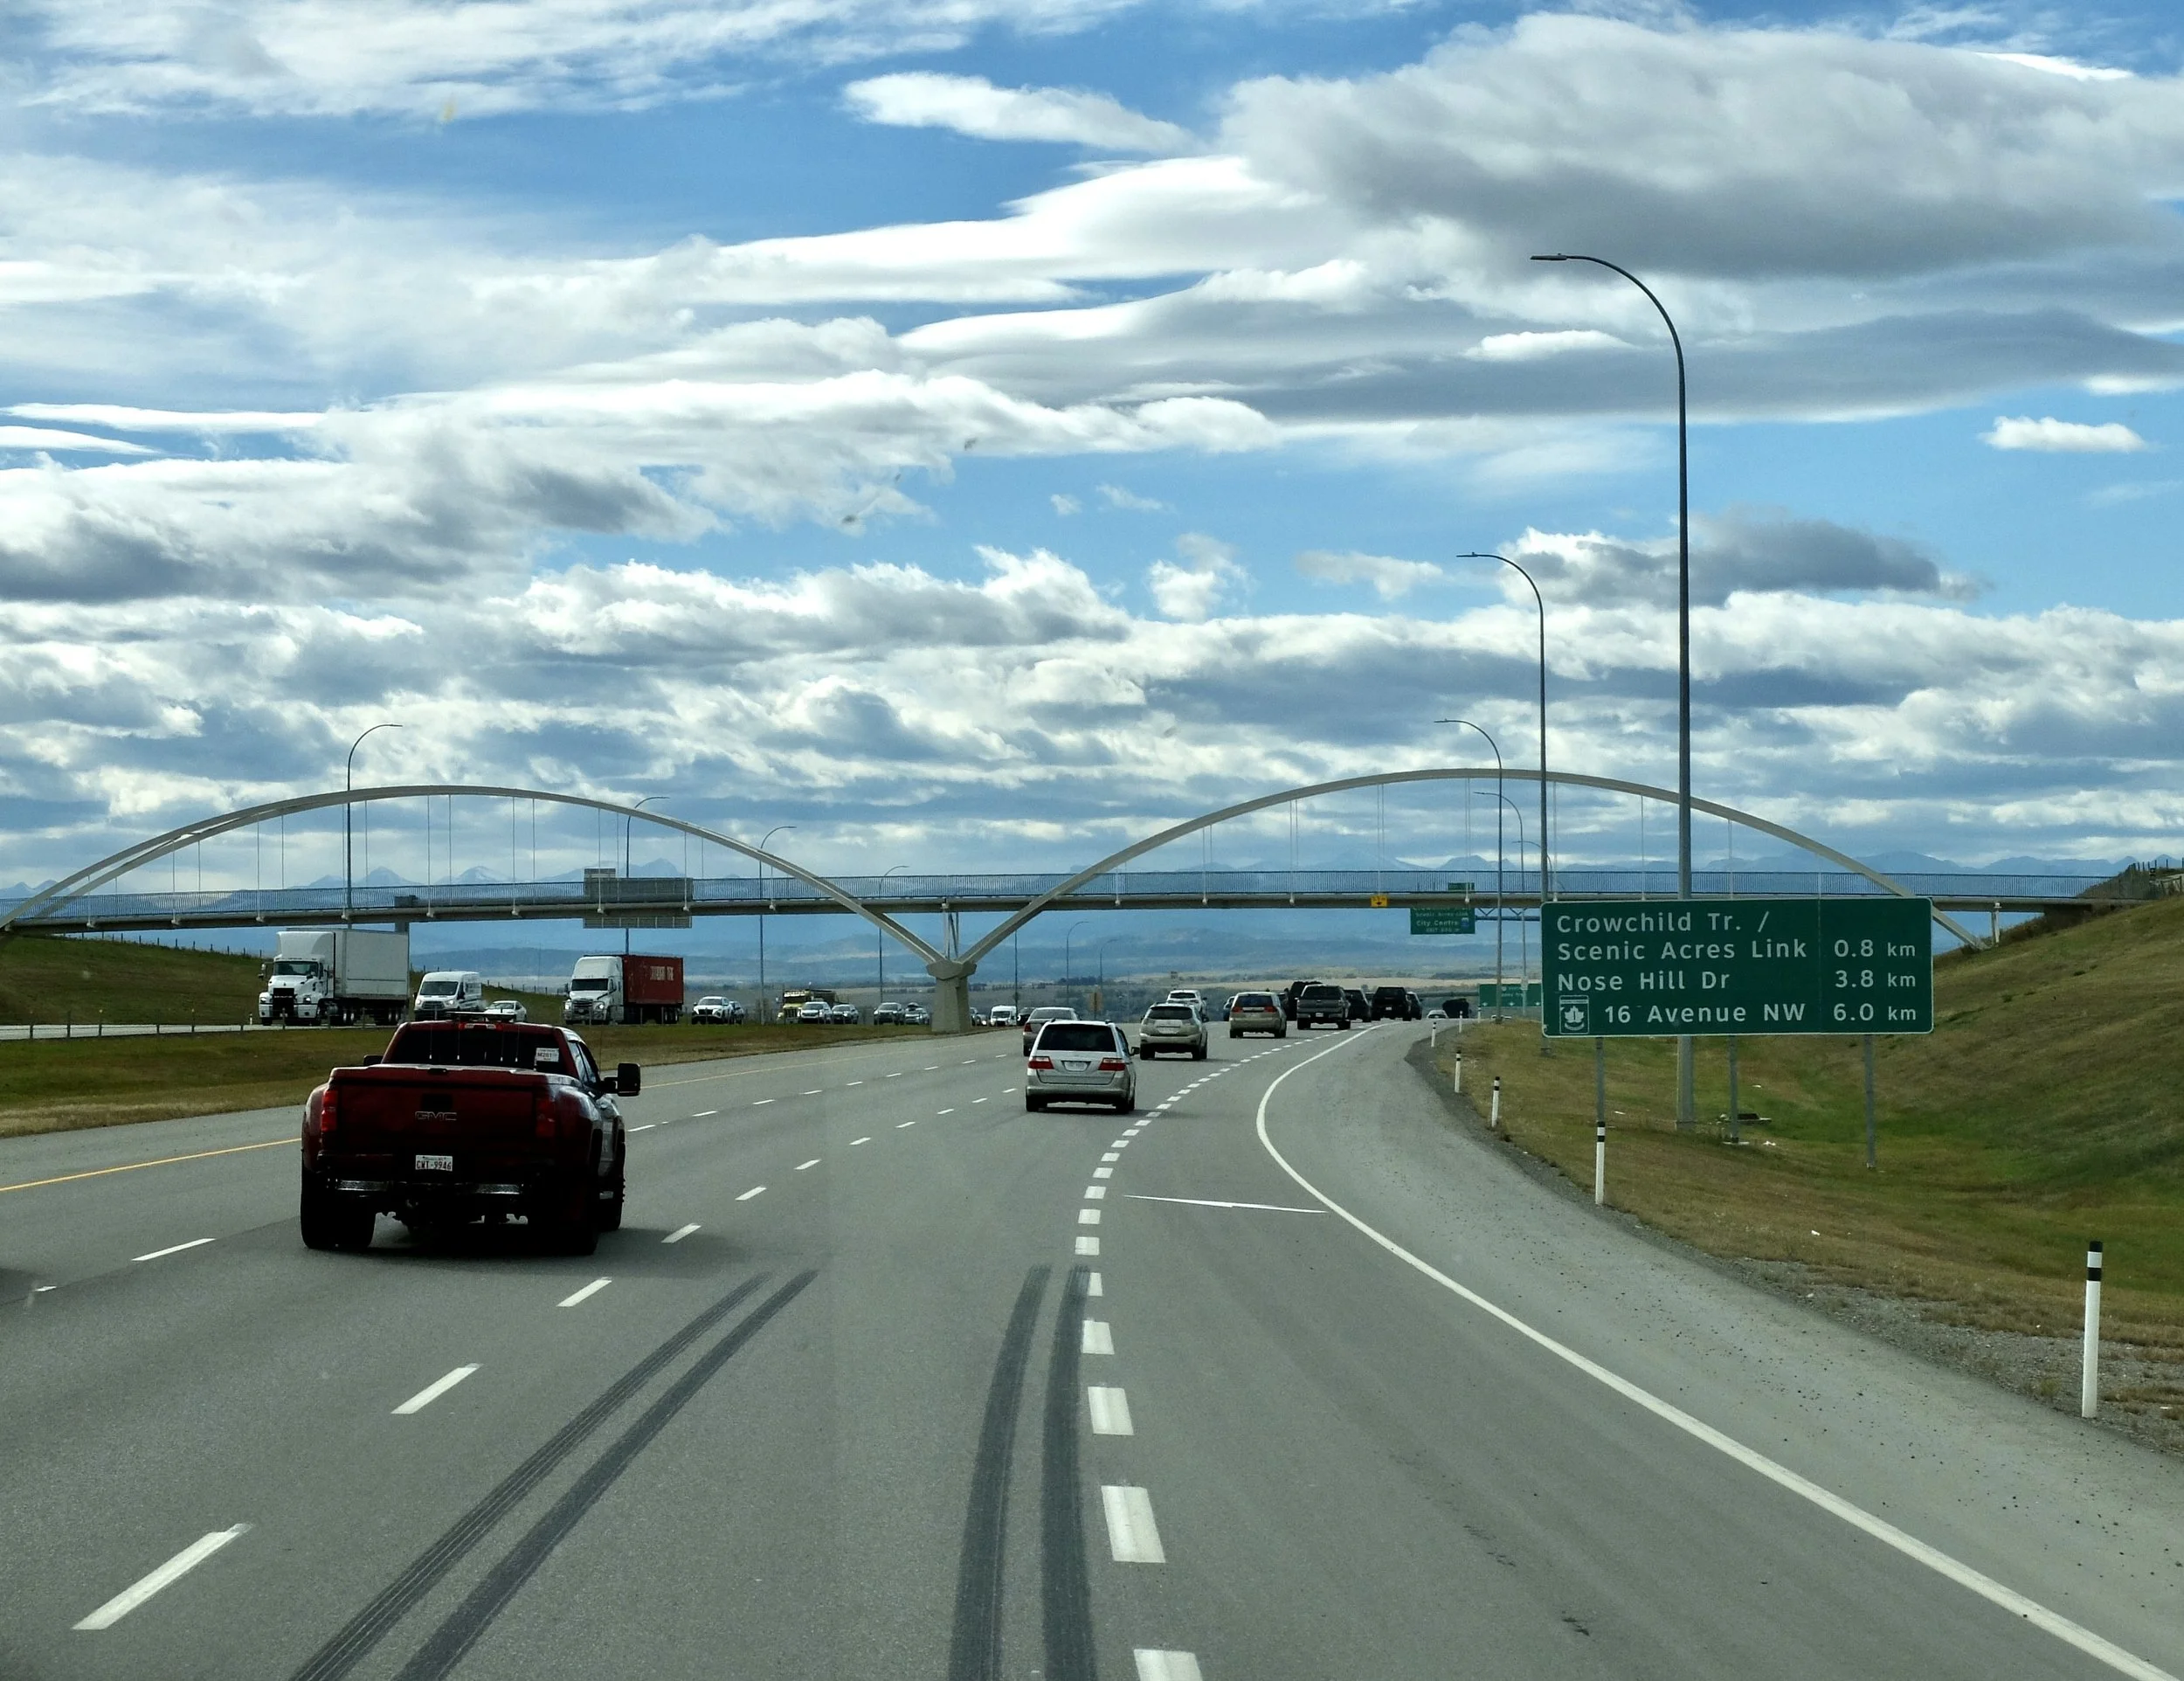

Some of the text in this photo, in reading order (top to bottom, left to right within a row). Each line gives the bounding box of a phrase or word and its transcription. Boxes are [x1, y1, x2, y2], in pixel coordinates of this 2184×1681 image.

[1556, 910, 1770, 933] Crowchild Tr. /
[1558, 938, 1916, 961] Scenic Acres Link 0.8 km
[1558, 970, 1916, 992] Nose Hill Dr 3.8 km
[1604, 1002, 1917, 1024] 16 Avenue NW 6.0 km
[415, 1110, 458, 1122] GMC
